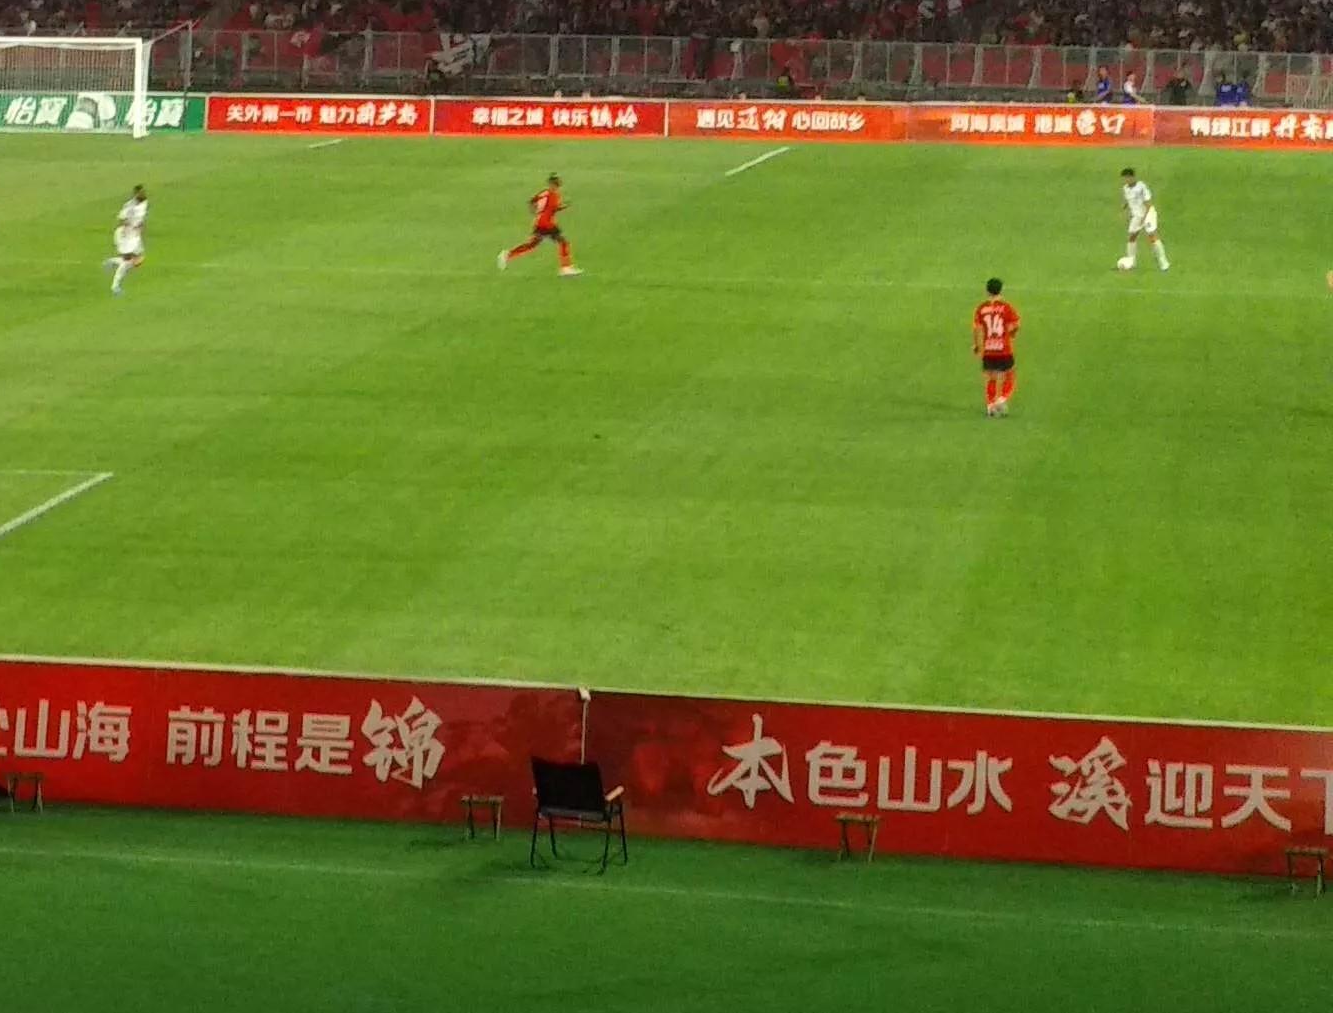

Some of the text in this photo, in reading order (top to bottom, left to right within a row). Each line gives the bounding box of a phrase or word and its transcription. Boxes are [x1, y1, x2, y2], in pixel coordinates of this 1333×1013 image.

[165, 696, 447, 789] 前程是锦
[706, 713, 1014, 815] 本色山水
